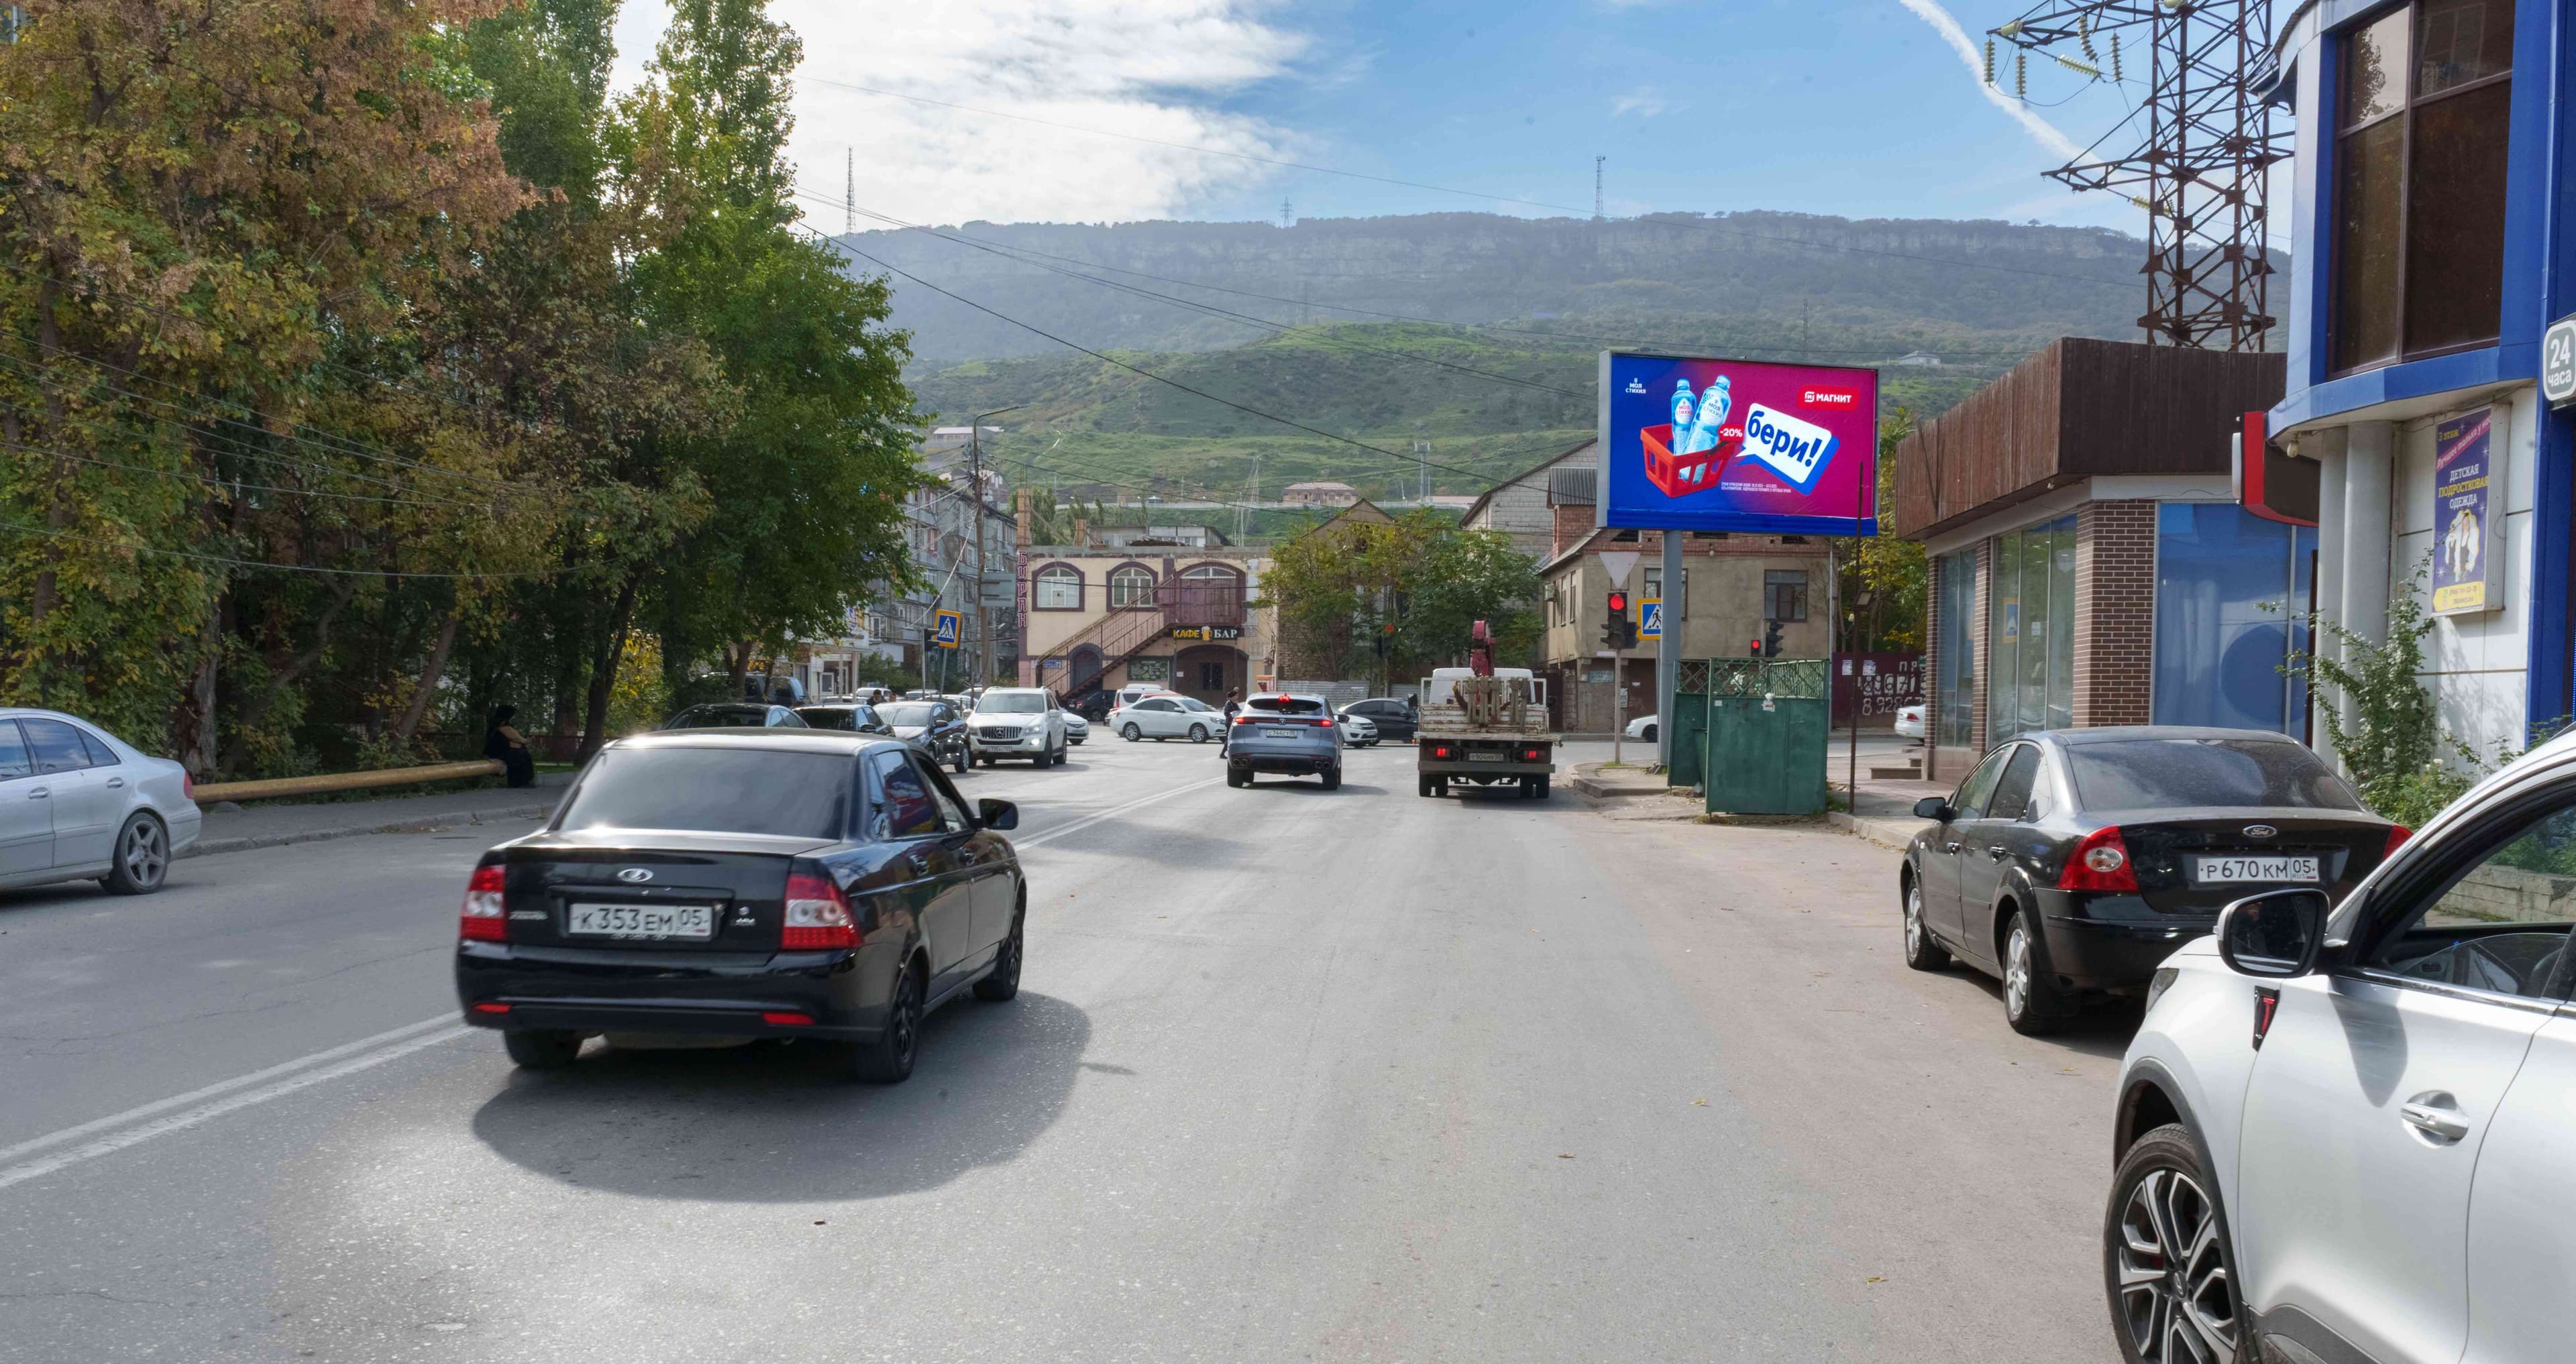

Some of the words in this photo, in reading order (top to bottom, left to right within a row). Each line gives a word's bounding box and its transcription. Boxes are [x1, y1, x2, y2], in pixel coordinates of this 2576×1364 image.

[2551, 335, 2571, 369] 24
[2548, 369, 2571, 387] часа
[1817, 394, 1851, 403] МАГНИТ
[1719, 428, 1743, 437] -20%
[1748, 410, 1823, 467] бери!
[2450, 463, 2479, 483] ДЕТСКАЯ
[2438, 475, 2489, 498] ПОДРОСТКОВАЯ
[2449, 494, 2477, 510] ОДЕЖДА
[1018, 551, 1027, 627] БУРАН
[1173, 629, 1199, 638] КАФЕ
[1214, 629, 1238, 638] БАР
[2207, 860, 2288, 878] Р670КМ
[2293, 860, 2311, 873] 05
[580, 908, 672, 931] К353ЕМ
[680, 909, 702, 925] 05
